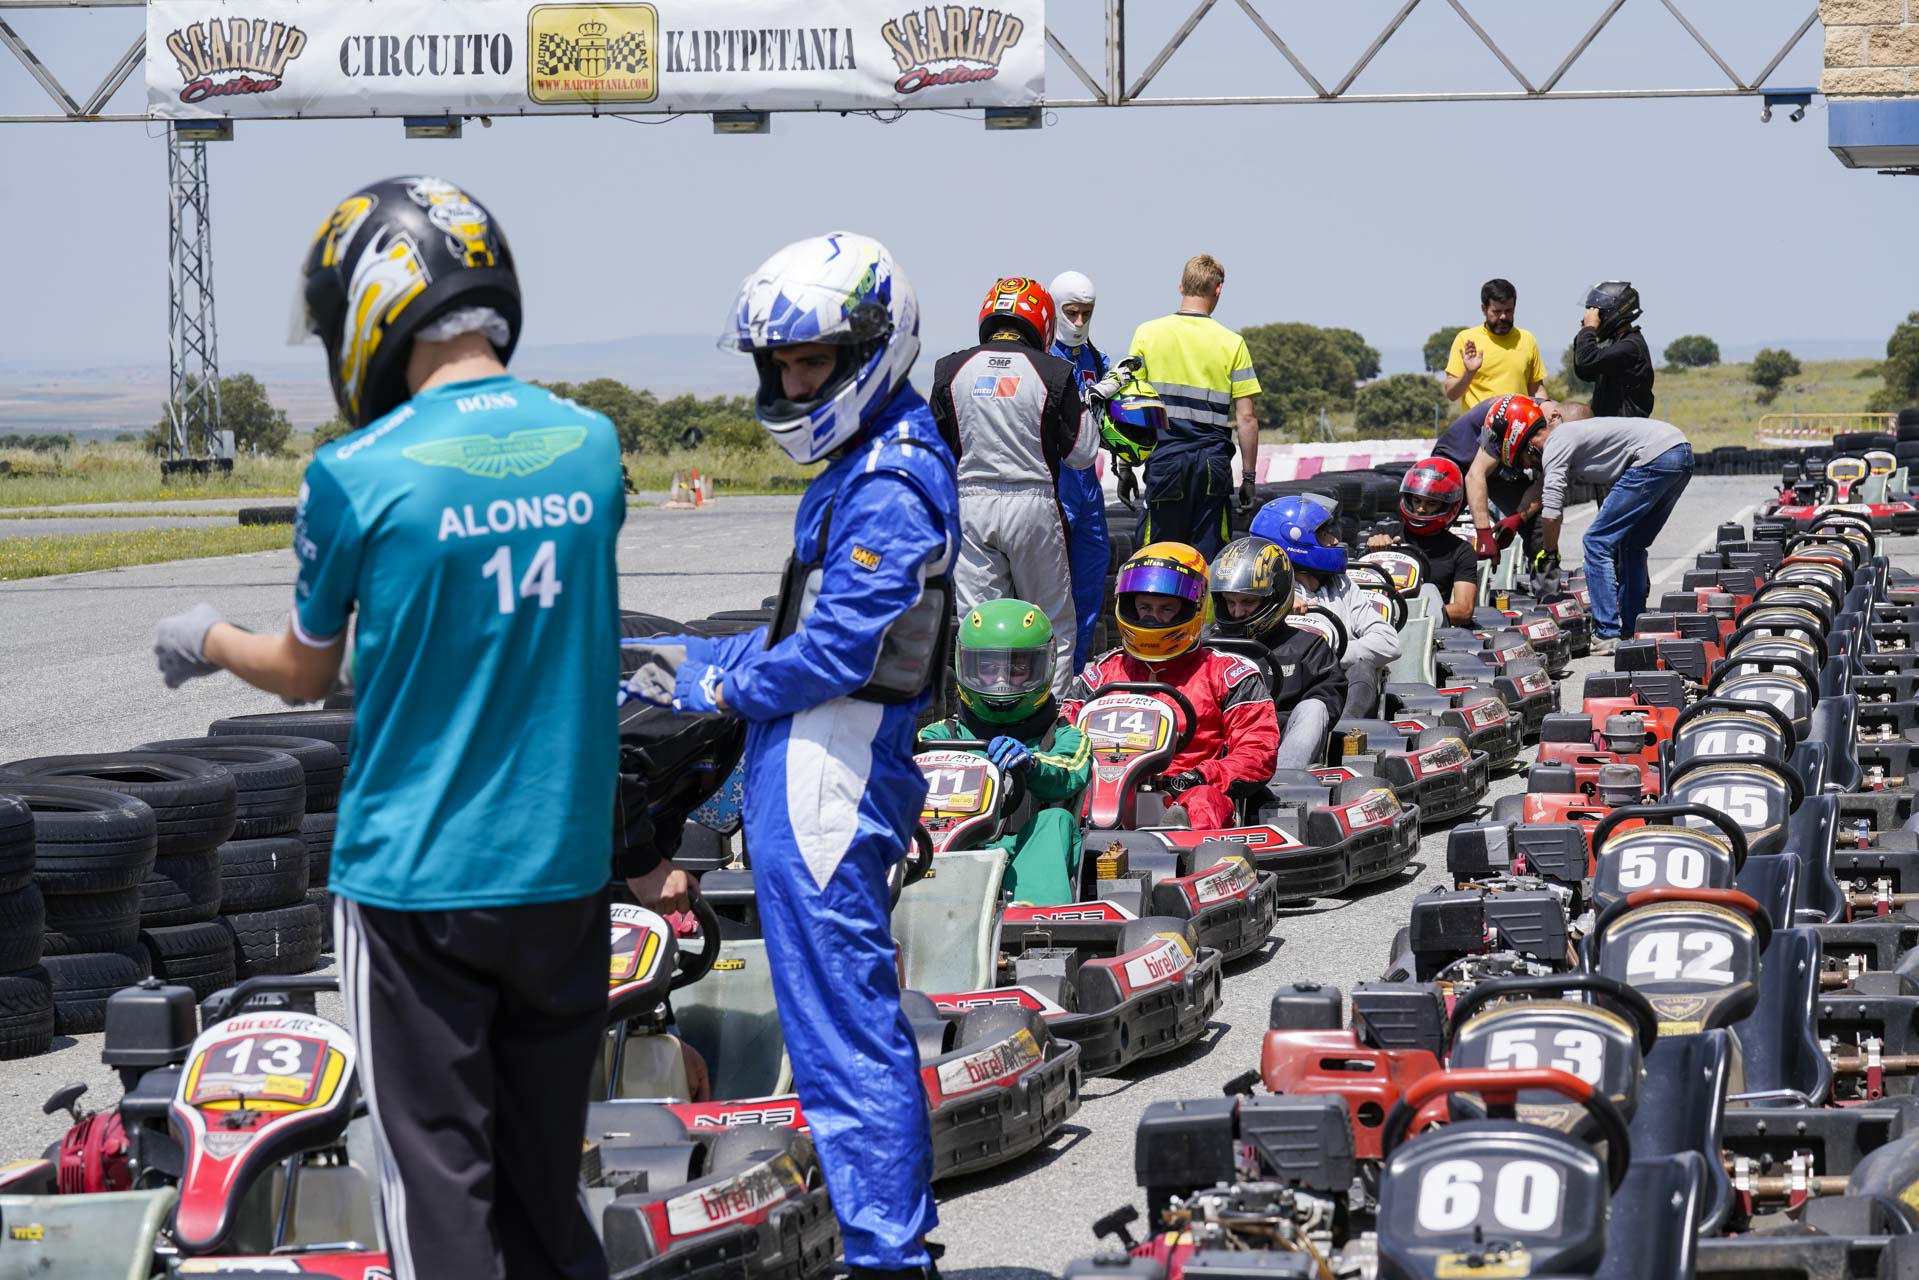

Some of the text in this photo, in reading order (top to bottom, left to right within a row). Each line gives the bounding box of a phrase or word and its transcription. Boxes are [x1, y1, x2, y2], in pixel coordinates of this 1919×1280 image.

[166, 17, 307, 83] SCARLIP
[339, 33, 513, 77] CIRCUITO
[537, 32, 550, 76] RACING
[666, 28, 857, 72] KARTPETANIA
[881, 4, 1024, 70] SCARLIP
[179, 74, 282, 103] Custom
[538, 79, 649, 91] WWW.KARTPETANIA.COM
[894, 64, 999, 95] Custom
[988, 358, 1012, 367] OMP
[438, 491, 593, 541] ALONSO
[482, 541, 562, 614] 14
[1101, 711, 1146, 733] 14
[923, 769, 965, 794] 11
[1686, 786, 1768, 828] 45
[1618, 847, 1704, 889] 50
[1626, 931, 1735, 983] 42
[225, 1037, 303, 1076] 13
[1488, 1028, 1605, 1086] 53
[1418, 1158, 1561, 1232] 60
